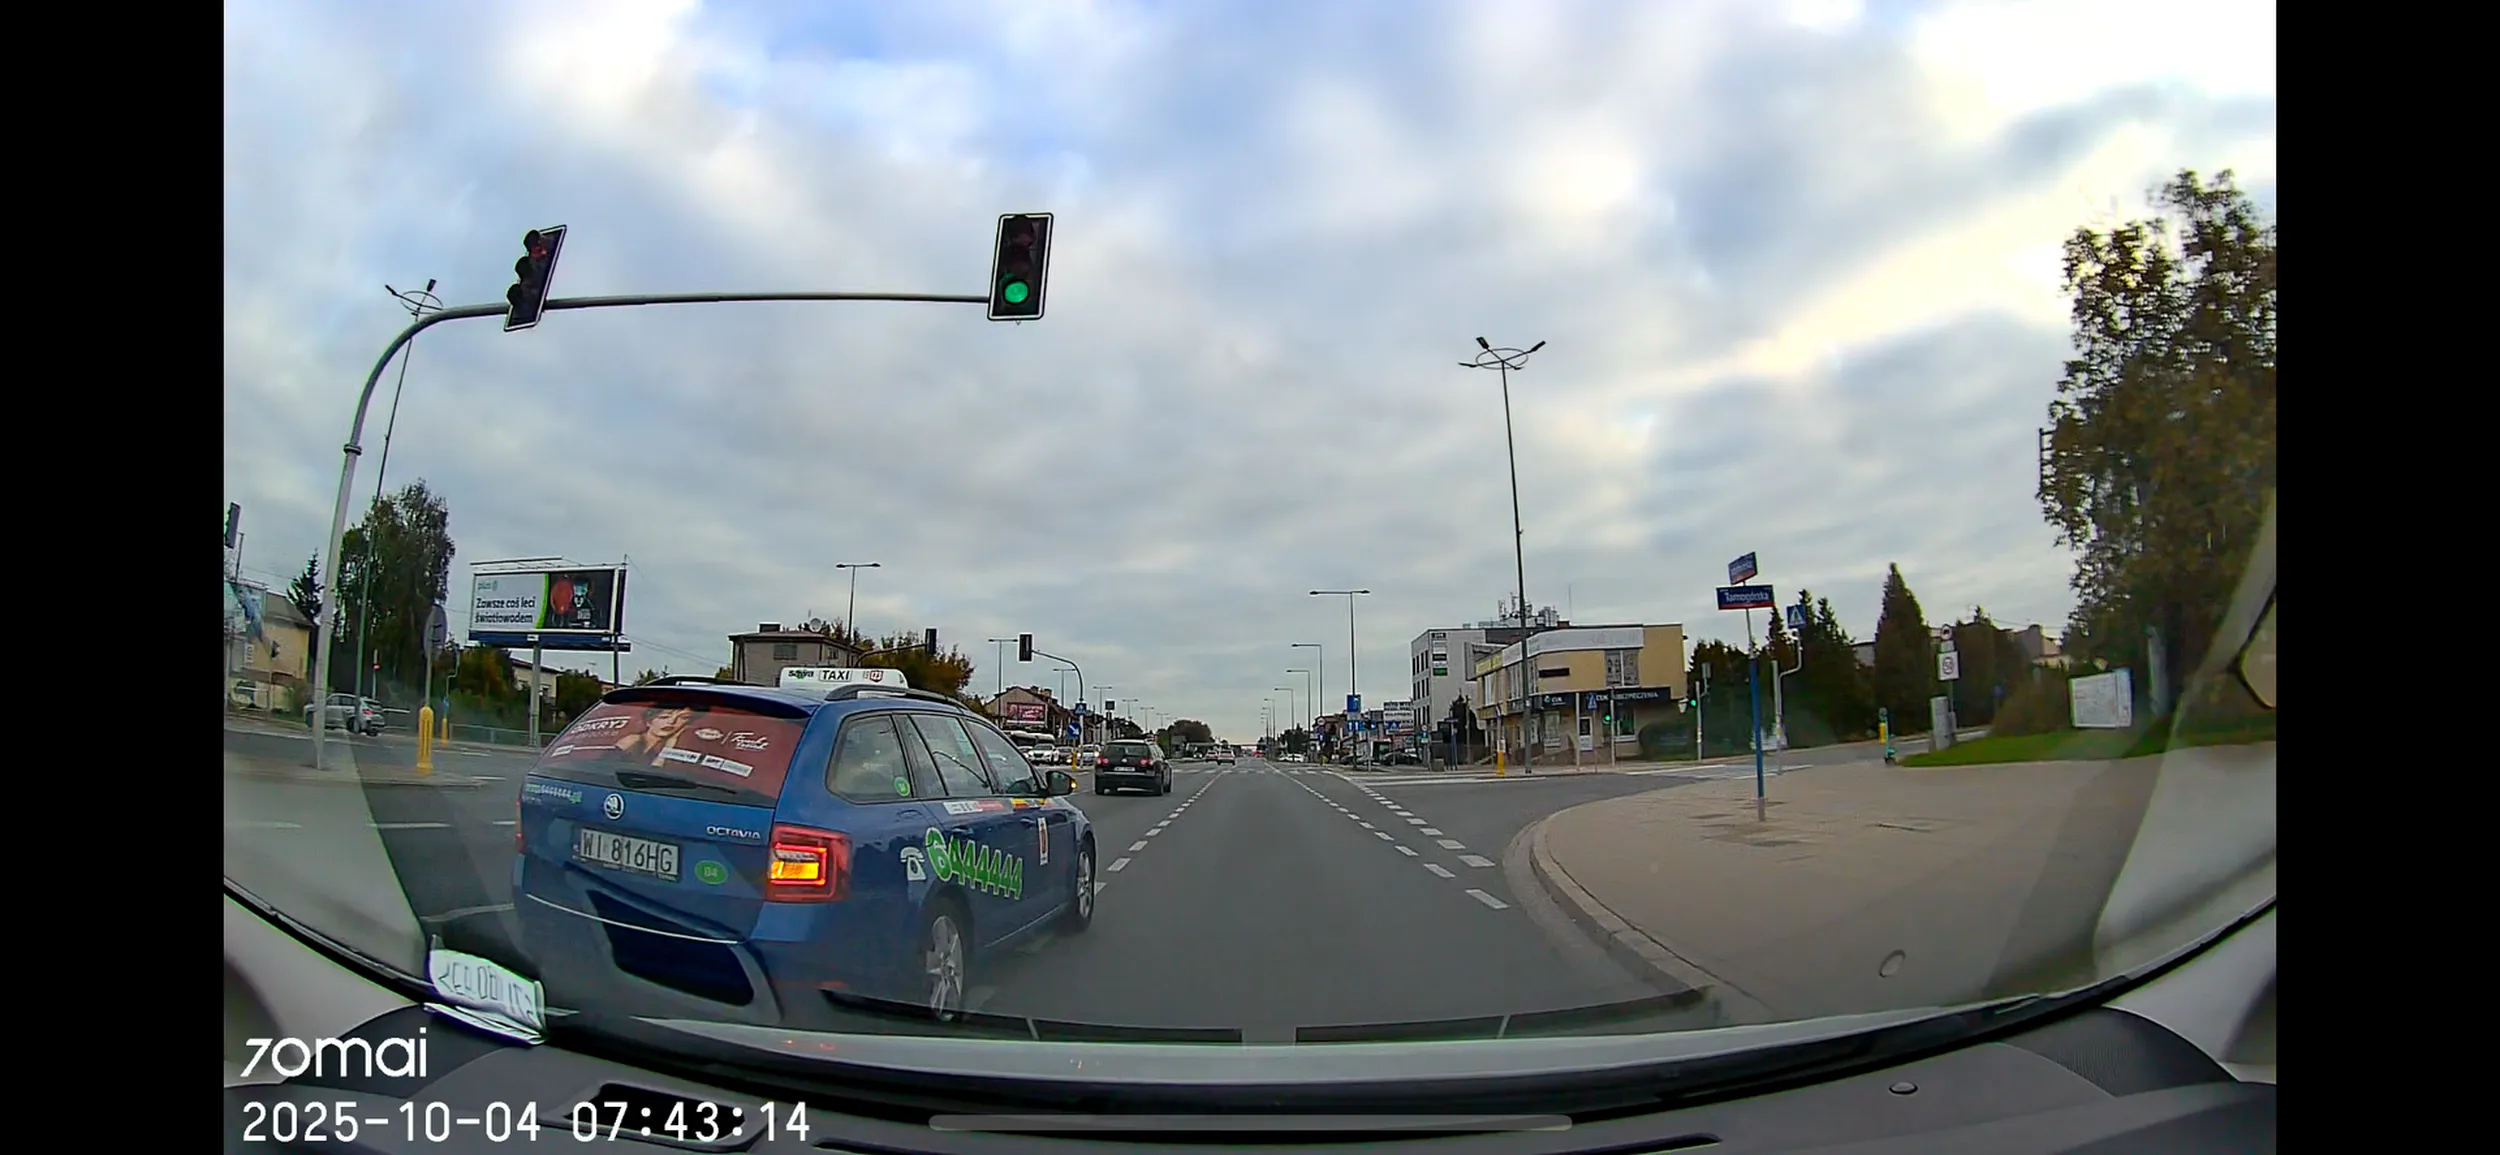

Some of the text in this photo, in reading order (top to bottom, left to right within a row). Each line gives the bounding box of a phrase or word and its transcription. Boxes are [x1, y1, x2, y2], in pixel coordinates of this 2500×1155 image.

[476, 595, 536, 609] Zawsze coś leci
[475, 611, 533, 623] światłowodem
[822, 670, 850, 680] TAXI
[706, 826, 761, 840] OCTAVIA
[583, 831, 602, 859] WI
[611, 838, 673, 873] 816HG
[925, 826, 1023, 900] 6444444
